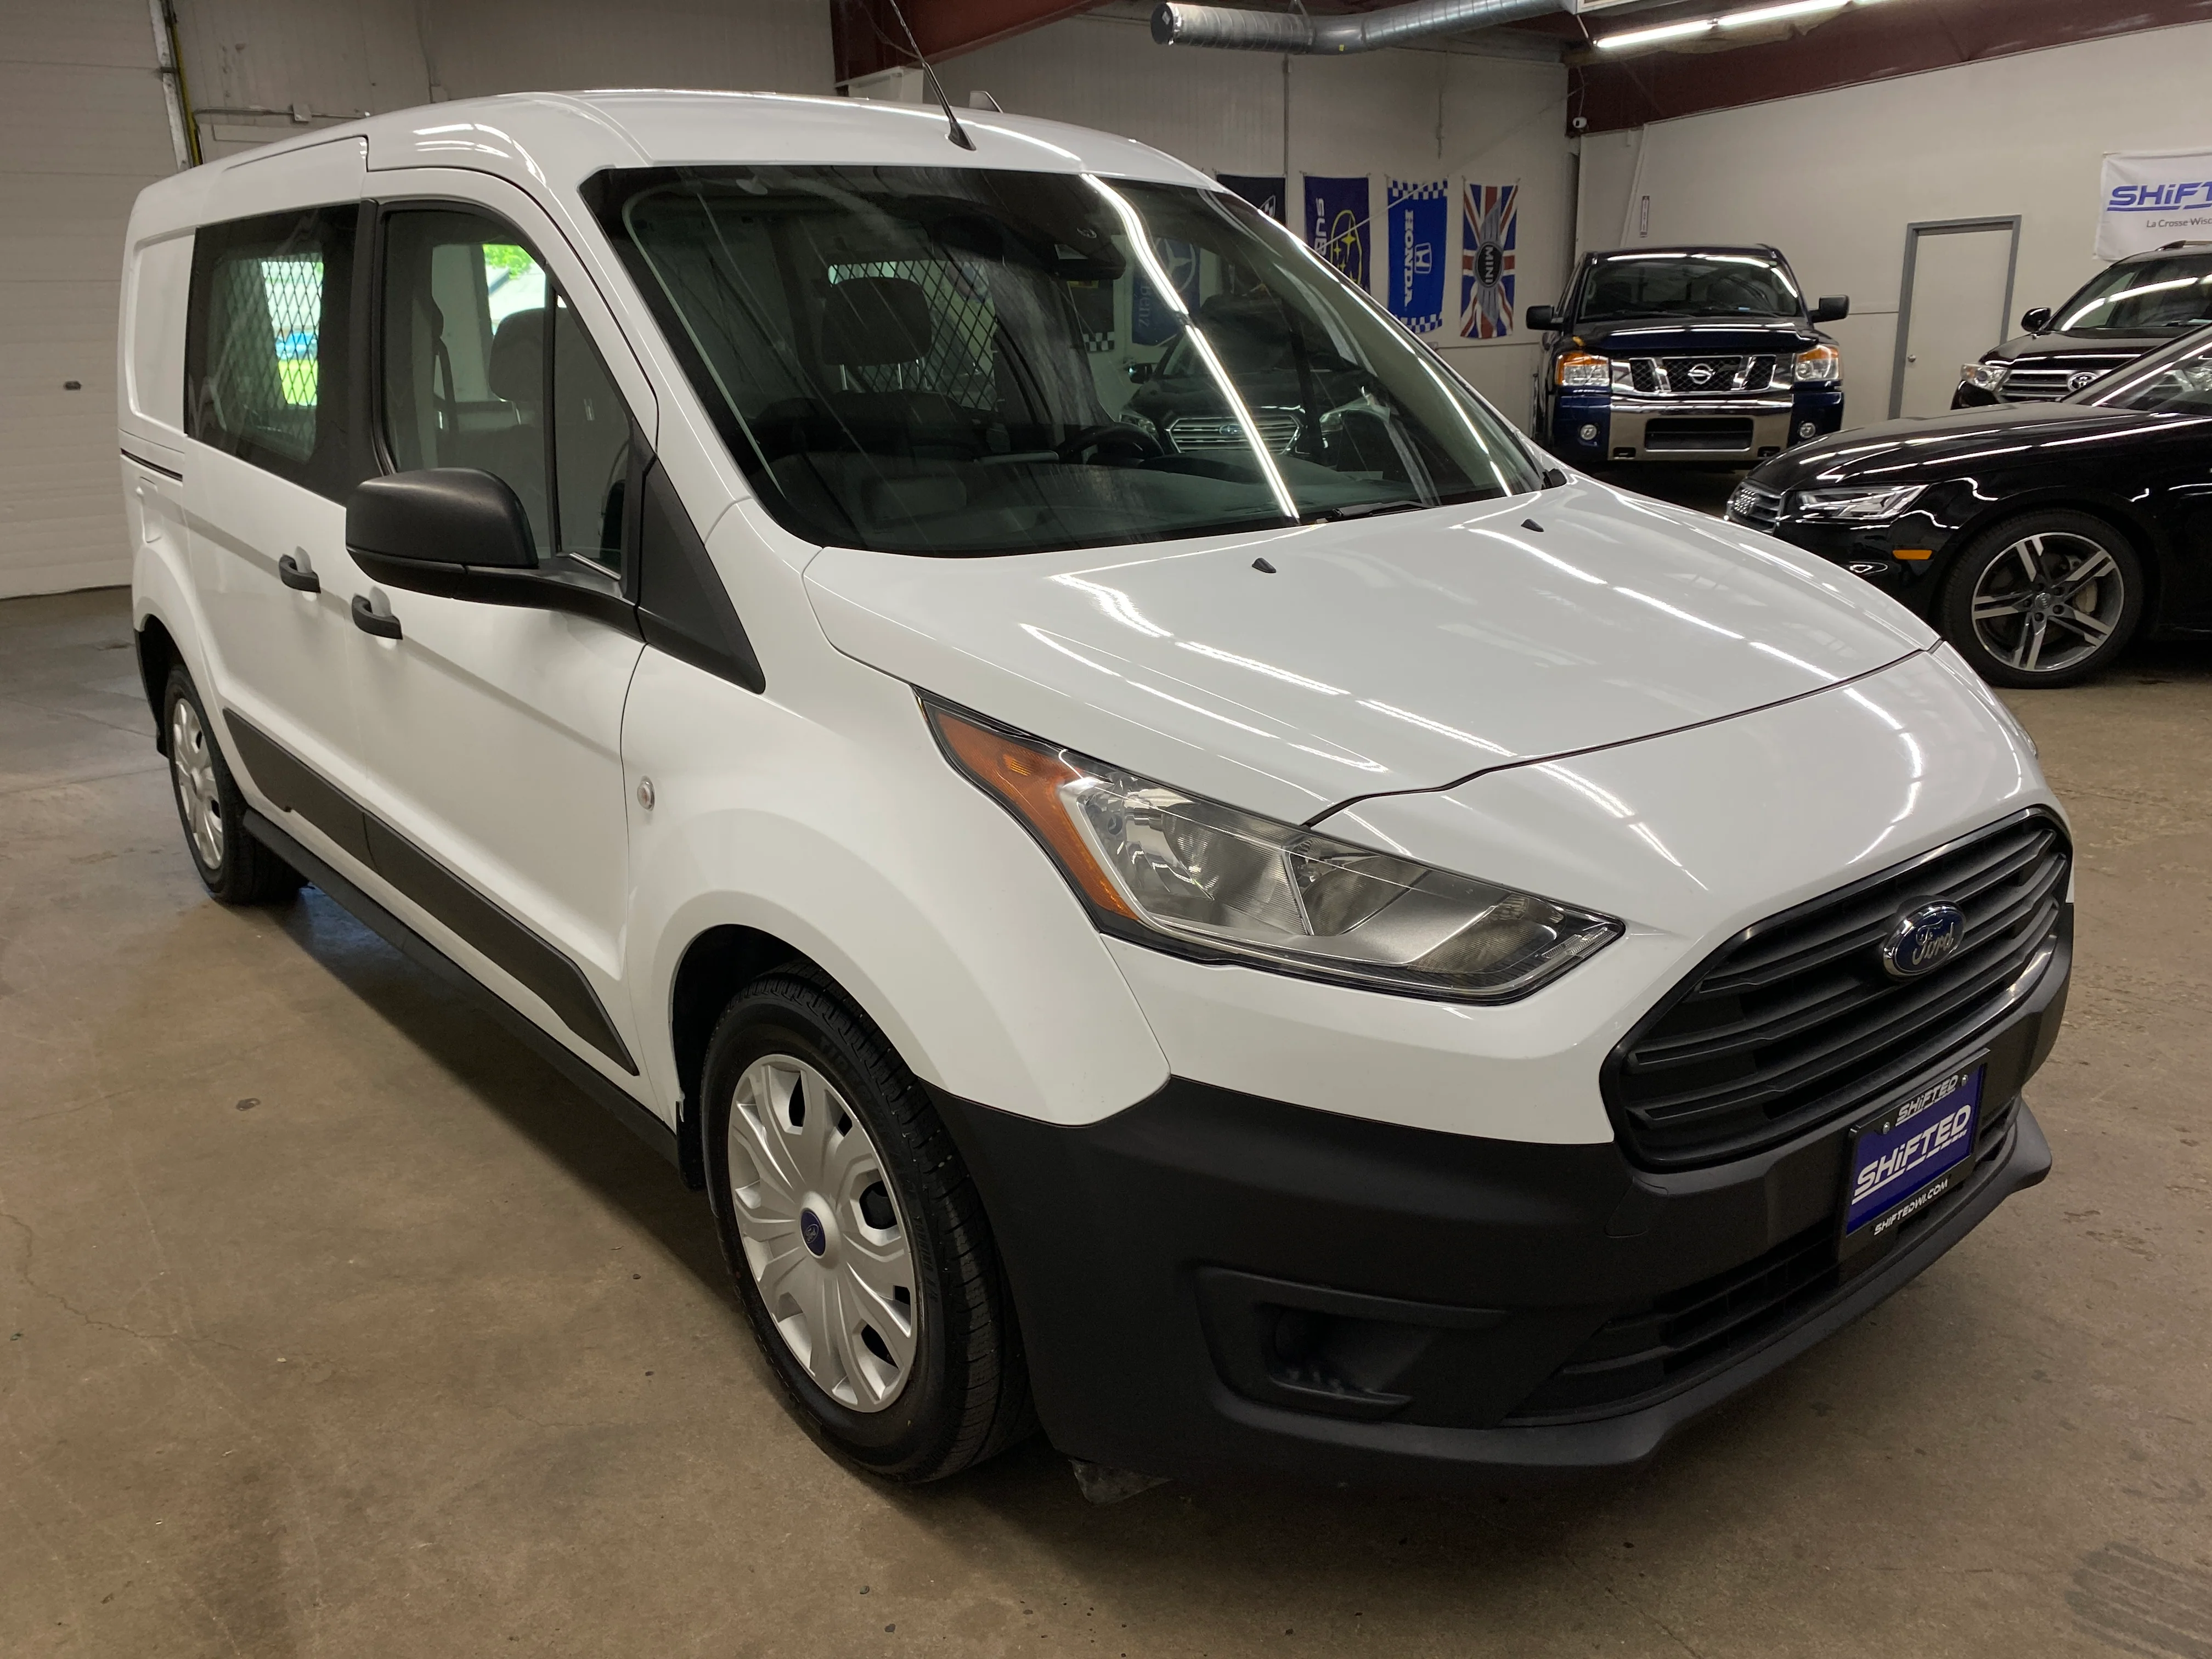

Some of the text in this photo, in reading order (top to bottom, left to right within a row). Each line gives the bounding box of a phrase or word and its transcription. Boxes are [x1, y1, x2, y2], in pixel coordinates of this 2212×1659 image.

[1314, 198, 1327, 256] SUB
[2158, 219, 2188, 227] Crosse
[1404, 210, 1414, 310] HONDA
[1485, 247, 1494, 283] MINI
[1912, 919, 1954, 965] Ford
[1874, 1178, 1948, 1236] SHIFTEDWI.COM
